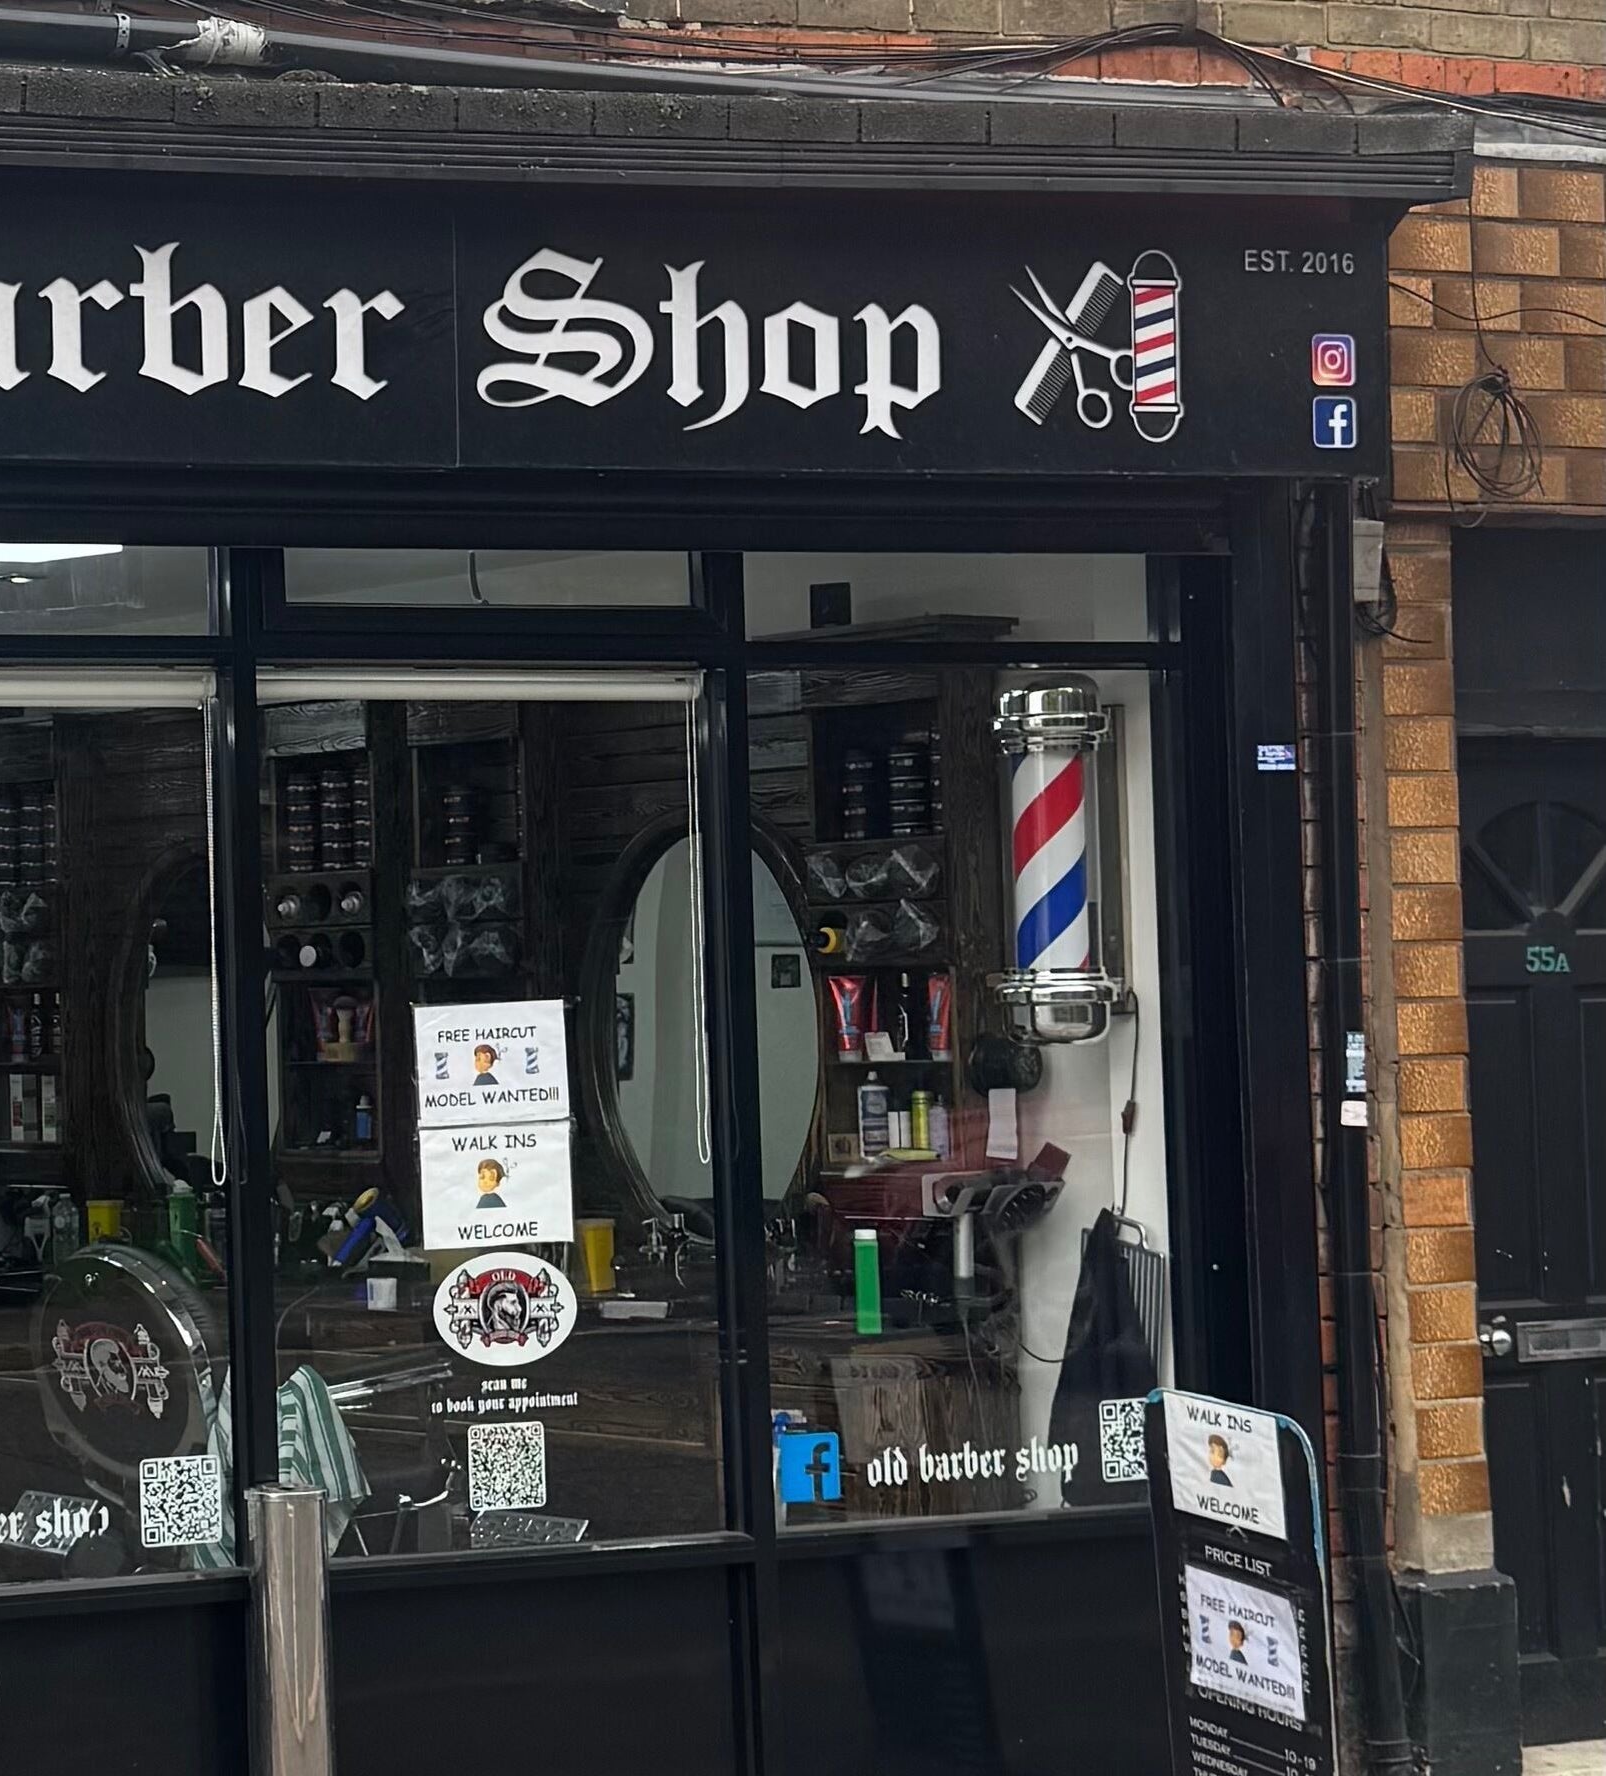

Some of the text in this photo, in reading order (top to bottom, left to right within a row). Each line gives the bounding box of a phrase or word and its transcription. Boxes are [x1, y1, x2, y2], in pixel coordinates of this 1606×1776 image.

[1244, 249, 1355, 275] EST. 2016
[476, 246, 942, 441] Shop
[1525, 945, 1571, 973] 55A
[437, 1026, 537, 1043] FREE HAIRCUT
[425, 1086, 560, 1108] MODEL WANTED!!!
[451, 1134, 537, 1151] WALK INS
[458, 1221, 539, 1240] WELCOME
[481, 1378, 527, 1393] scan me
[446, 1396, 474, 1413] book
[478, 1397, 505, 1414] your
[508, 1392, 578, 1413] appointment
[1186, 1405, 1252, 1433] WALK INS
[866, 1435, 1079, 1488] old barber shop
[1197, 1493, 1260, 1524] WELCOME
[1204, 1544, 1273, 1577] PRICE LIST
[1200, 1593, 1276, 1628] FREE HAIRCUT
[1195, 1653, 1232, 1678] MODEL
[1189, 1715, 1228, 1738] MONDAY
[1190, 1732, 1231, 1756] TUESDAY
